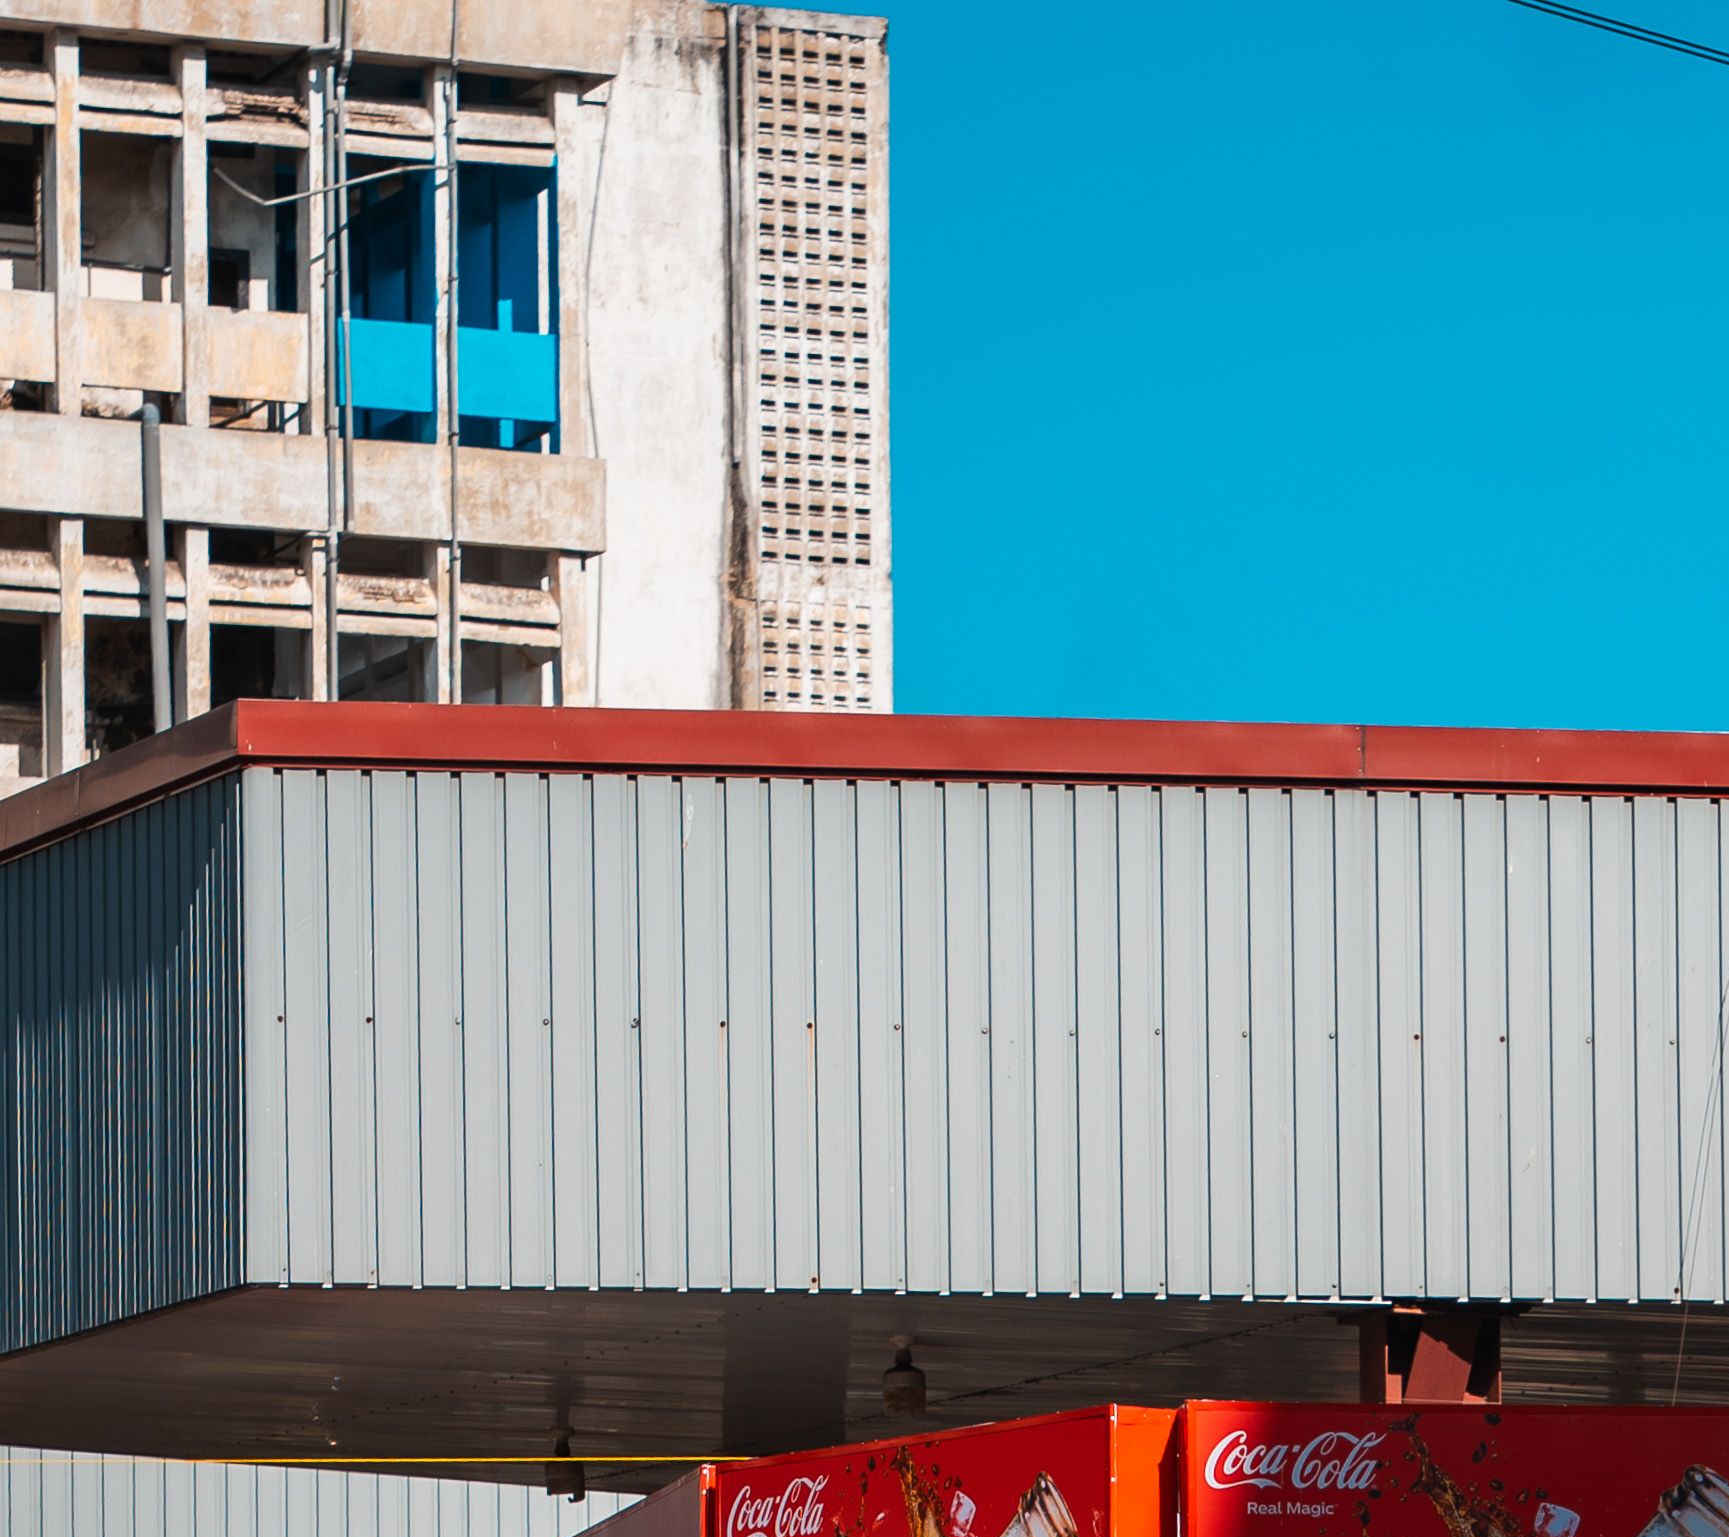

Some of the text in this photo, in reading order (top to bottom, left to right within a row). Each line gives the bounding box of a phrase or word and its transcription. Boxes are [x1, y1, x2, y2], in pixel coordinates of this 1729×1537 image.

[1203, 1430, 1387, 1490] Coca-Cola
[1247, 1501, 1335, 1518] Real Magic
